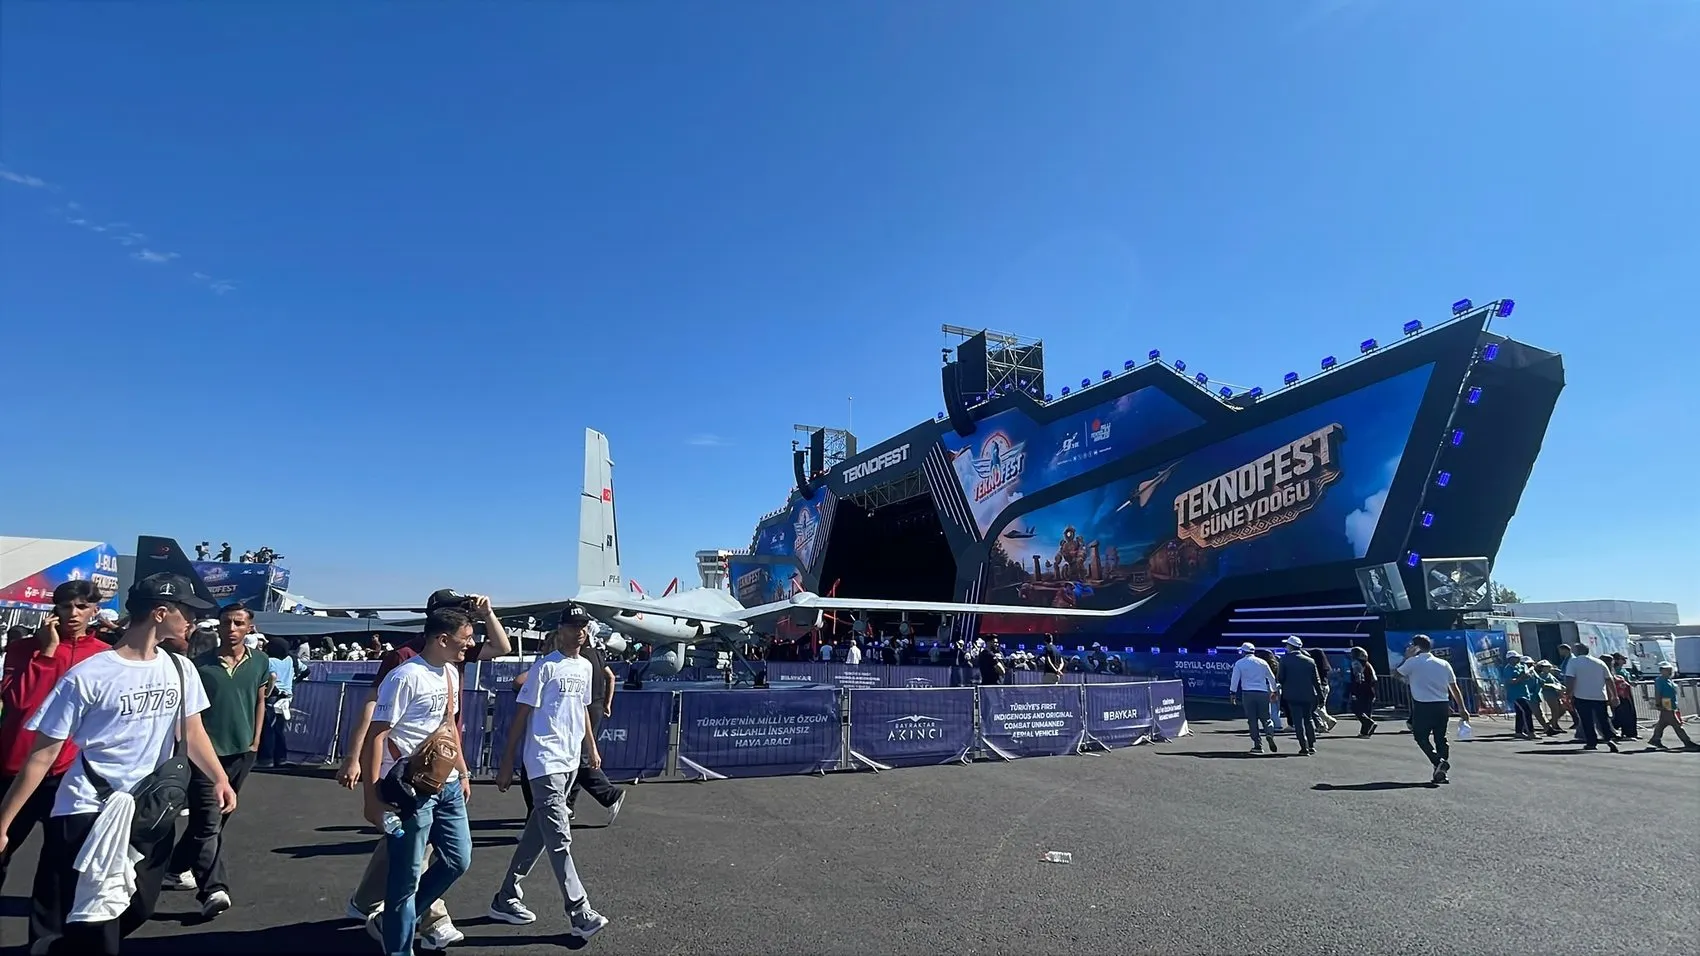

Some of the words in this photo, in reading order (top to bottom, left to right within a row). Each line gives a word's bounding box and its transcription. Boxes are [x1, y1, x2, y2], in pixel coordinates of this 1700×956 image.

[843, 443, 910, 484] TEKNOFEST
[1174, 423, 1342, 525] TEKNOFEST
[1201, 479, 1310, 539] GÜNEYDOĞU
[92, 573, 119, 590] TEKNOFES
[120, 688, 178, 716] 1773
[757, 714, 781, 725] MİLLİ
[784, 716, 796, 724] VE
[796, 714, 828, 724] ÖZGÜN
[994, 712, 1031, 721] INDIGENOUS
[1032, 712, 1045, 720] AND
[1046, 711, 1073, 719] ORIGINAL
[1109, 709, 1137, 719] BAYKAR
[714, 728, 729, 737] İLK
[768, 725, 810, 735] İNSANSIZ
[1004, 722, 1030, 730] COMBAT
[1031, 720, 1064, 728] UNMANNED
[887, 728, 943, 741] AKINCI
[1035, 729, 1059, 737] VEHICLE
[735, 739, 760, 748] HAVA
[763, 738, 792, 746] ARACI
